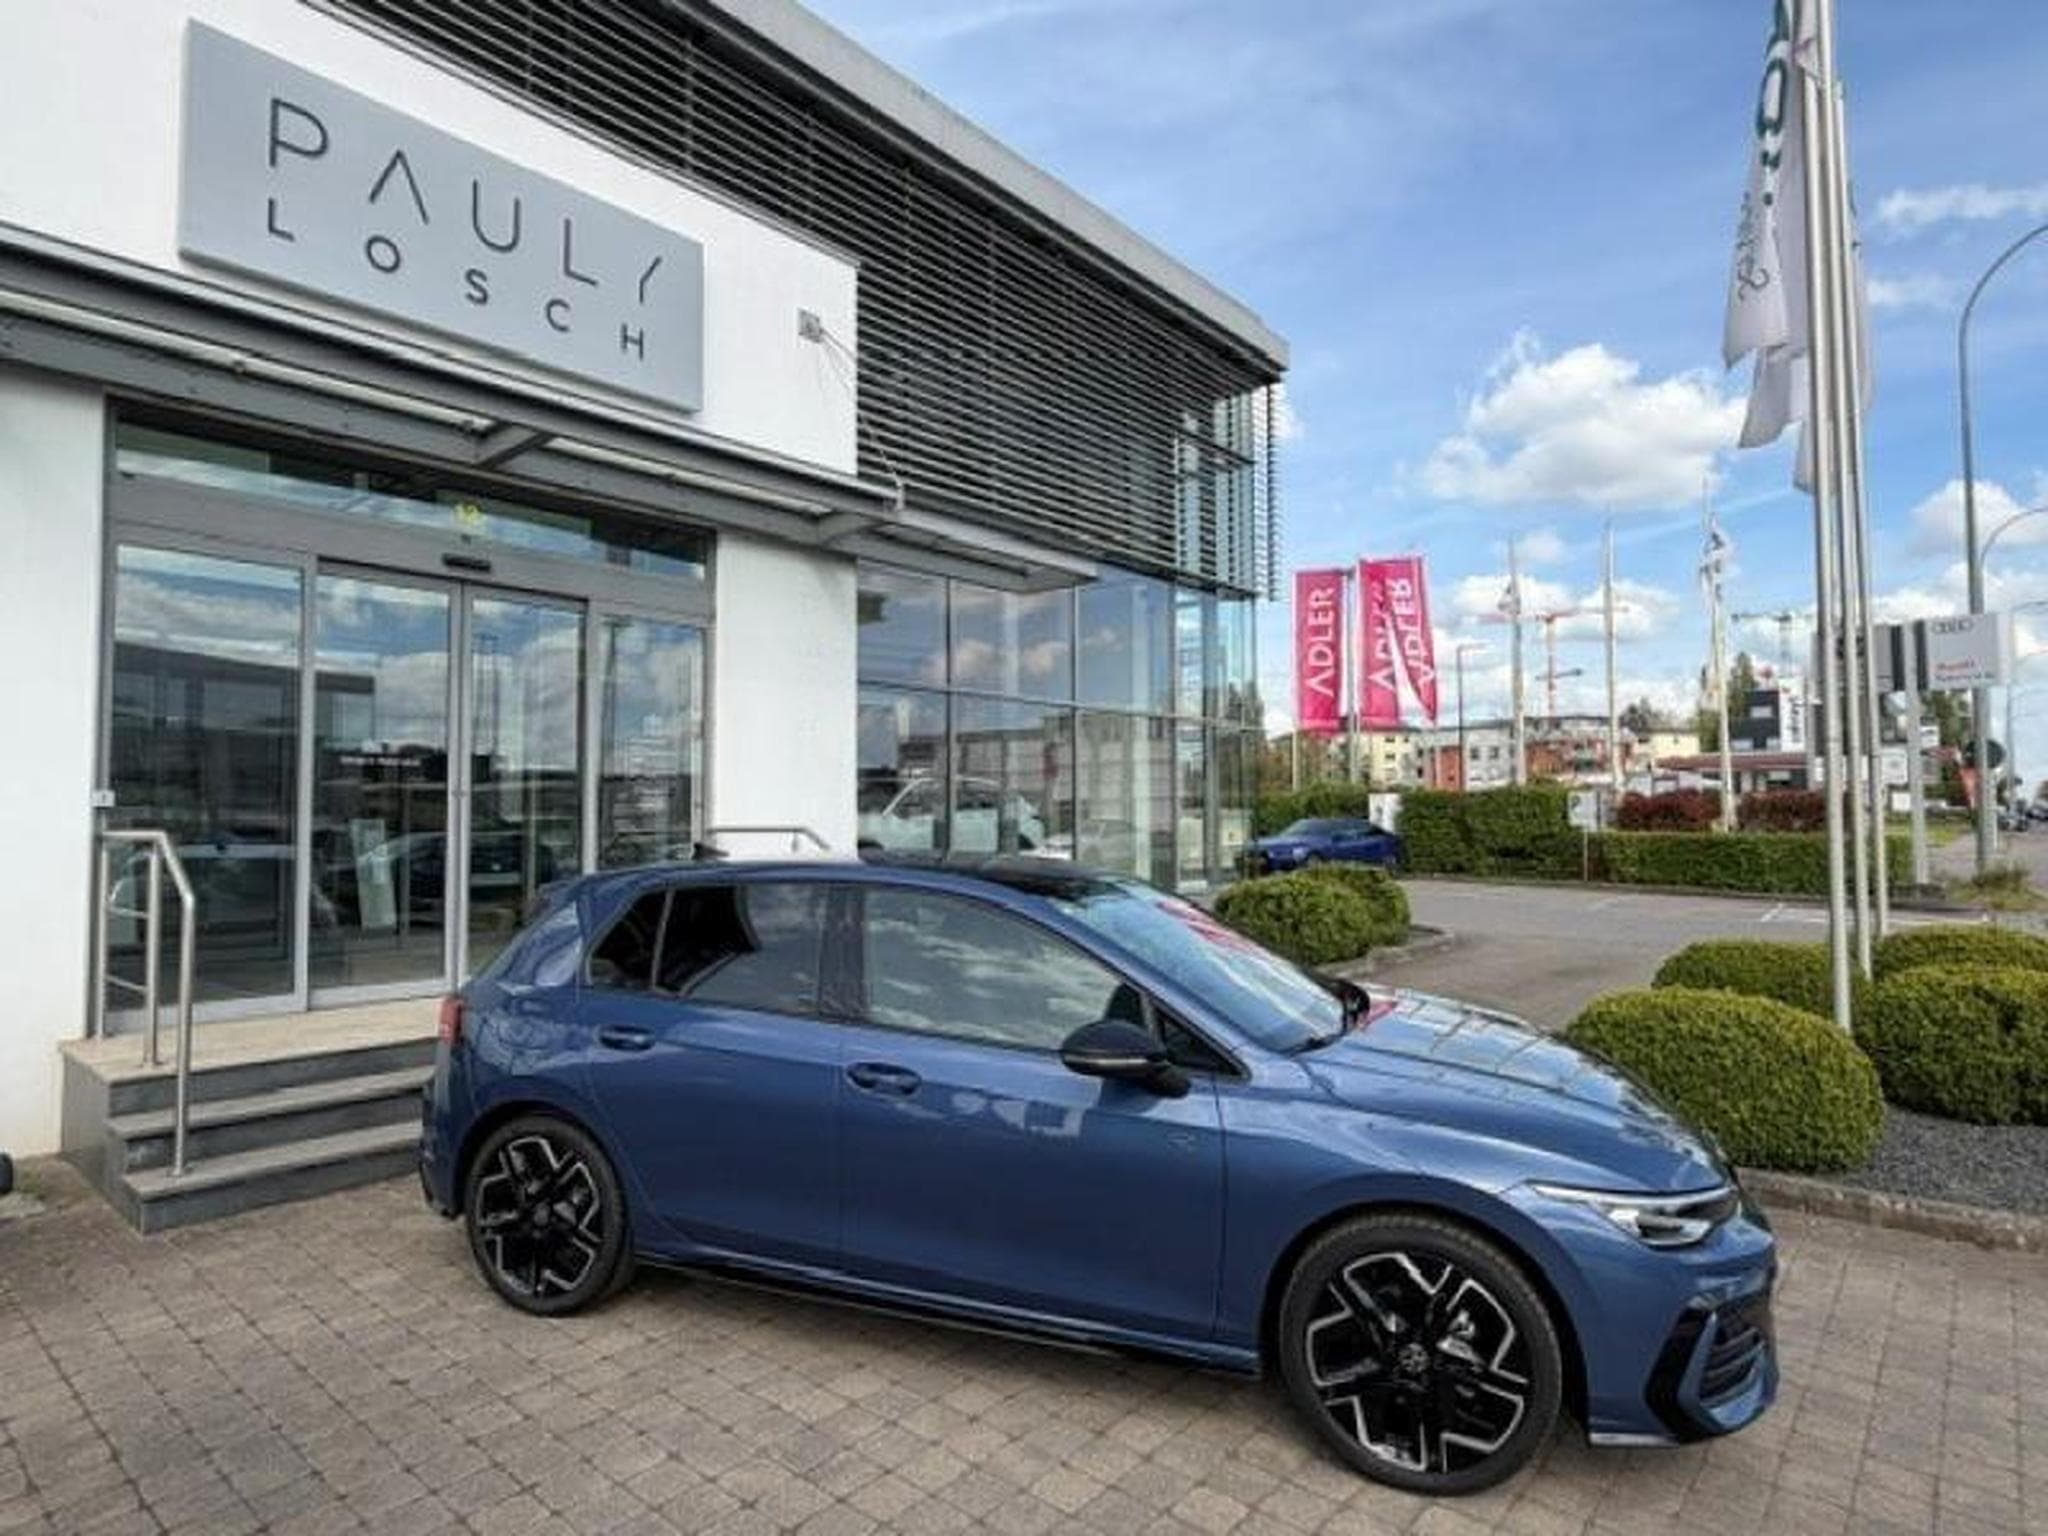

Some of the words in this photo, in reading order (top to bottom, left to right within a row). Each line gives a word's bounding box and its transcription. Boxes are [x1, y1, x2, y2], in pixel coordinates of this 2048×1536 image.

[267, 198, 644, 359] LOSCH
[269, 97, 662, 303] PAULY
[1304, 587, 1336, 697] ADLER
